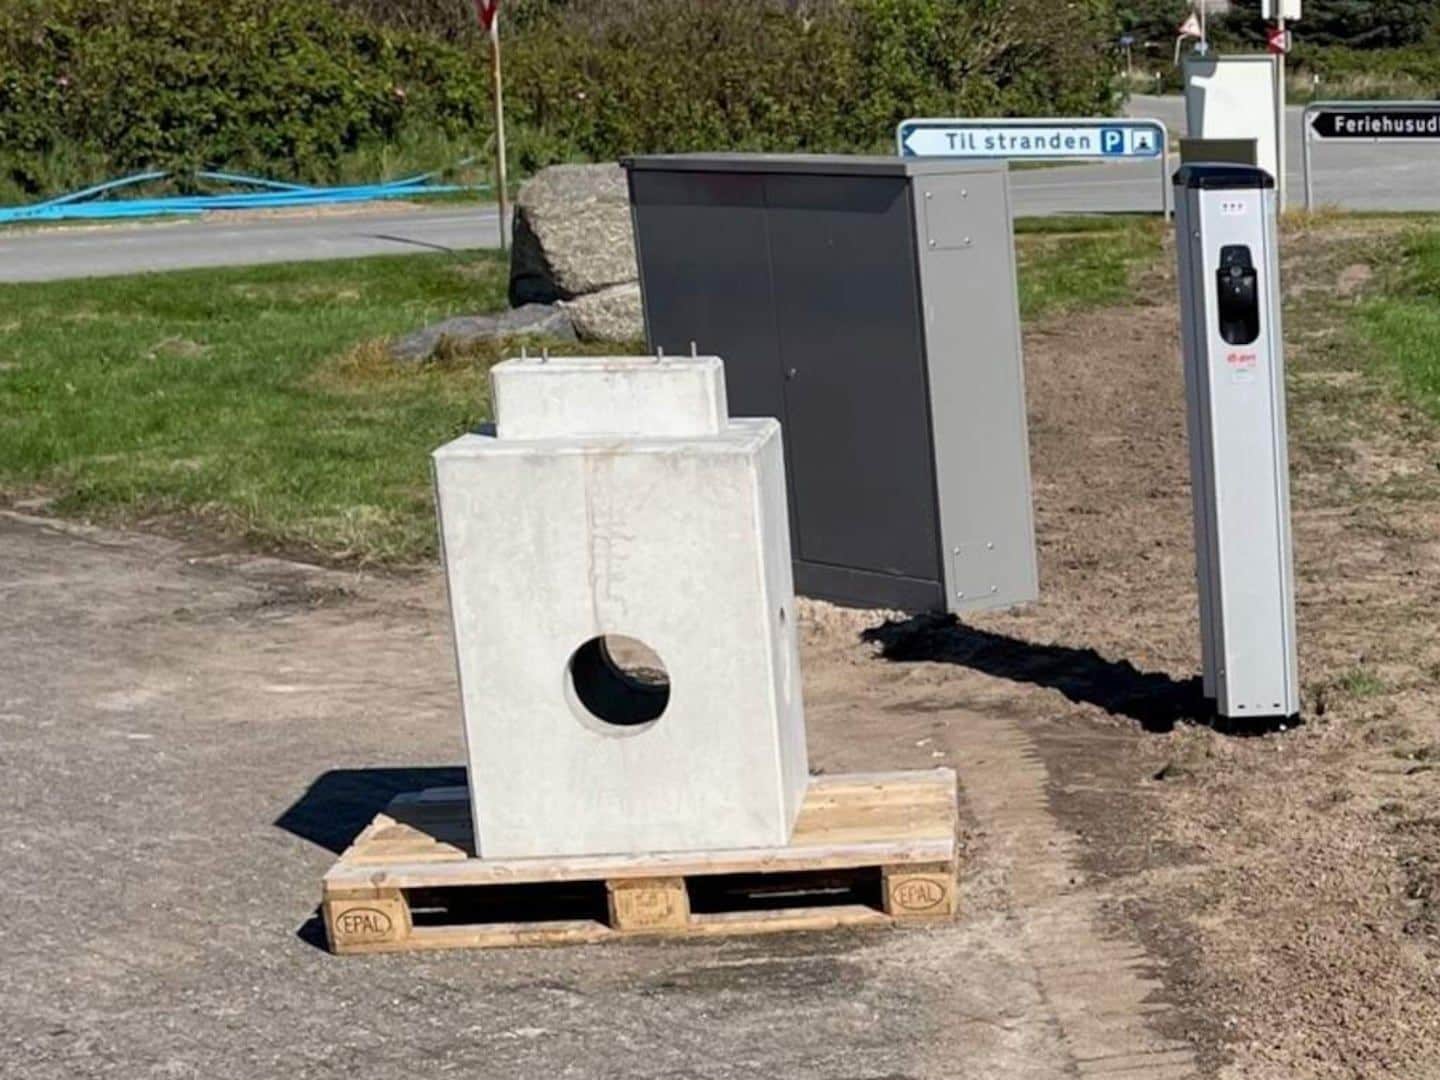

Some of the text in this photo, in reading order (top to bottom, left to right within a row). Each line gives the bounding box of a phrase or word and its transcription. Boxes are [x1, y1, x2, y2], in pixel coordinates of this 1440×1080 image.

[946, 130, 1121, 150] Til stranden P
[898, 885, 938, 904] EPAL
[344, 914, 386, 934] EPAL
